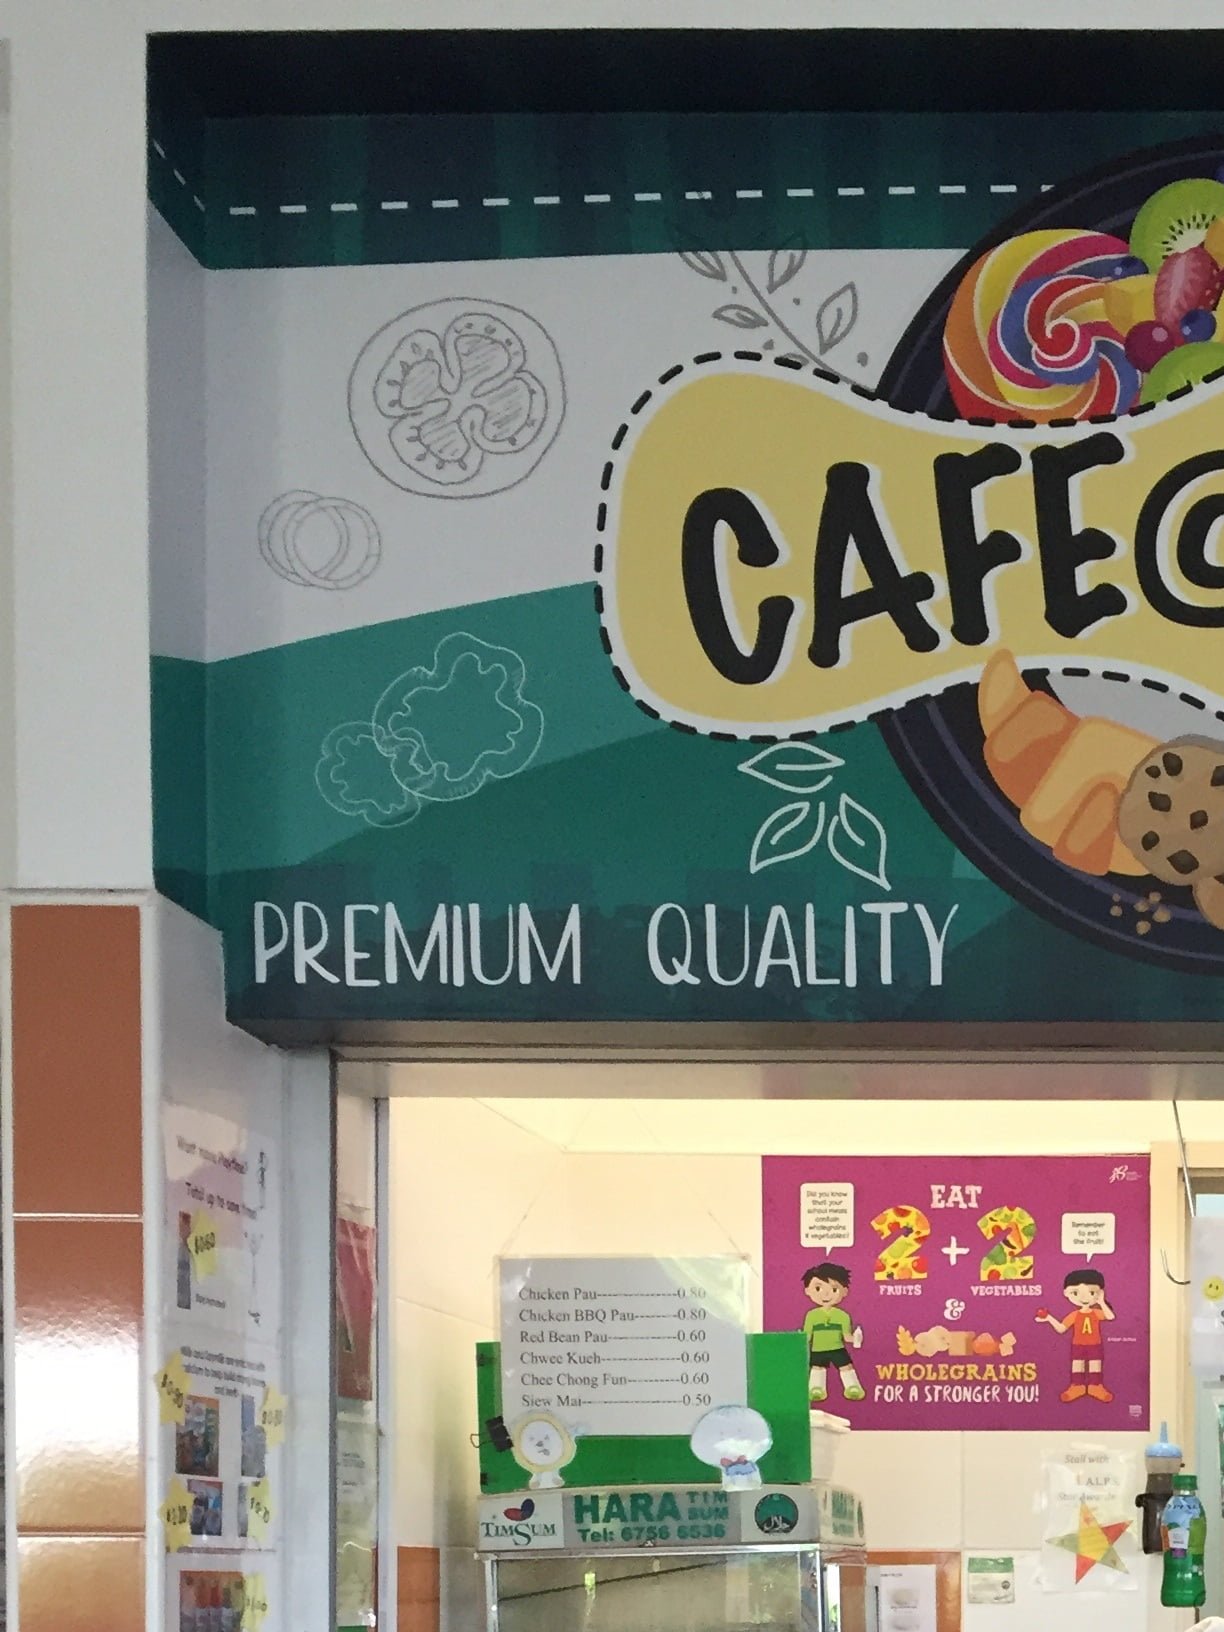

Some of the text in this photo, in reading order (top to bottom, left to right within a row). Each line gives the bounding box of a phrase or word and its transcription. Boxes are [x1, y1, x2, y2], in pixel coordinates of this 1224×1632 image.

[252, 899, 960, 988] PREMIUM QUALITY
[930, 1184, 983, 1209] EAT
[870, 1204, 931, 1281] 2
[976, 1204, 1036, 1282] 2
[518, 1287, 570, 1301] Chicken
[573, 1287, 598, 1301] Pau
[879, 1284, 922, 1296] FRUITS
[970, 1284, 1042, 1297] VEGETABLES
[518, 1307, 707, 1323] Chicken BBQ Pau 0.80
[943, 1298, 966, 1321] &
[520, 1329, 706, 1343] Red Bean Pau 0.60
[519, 1350, 710, 1365] Chwee Kueh 0.60
[520, 1371, 710, 1389] Chee Chong Fun 0.60
[875, 1363, 1037, 1382] WHOLEGRAINS
[521, 1394, 552, 1407] Siew
[682, 1393, 712, 1406] 0.50
[874, 1384, 1040, 1404] FOR A STRONGER YOU!
[686, 1490, 728, 1504] TIM
[573, 1491, 682, 1524] HARA
[577, 1528, 615, 1543] Tel:
